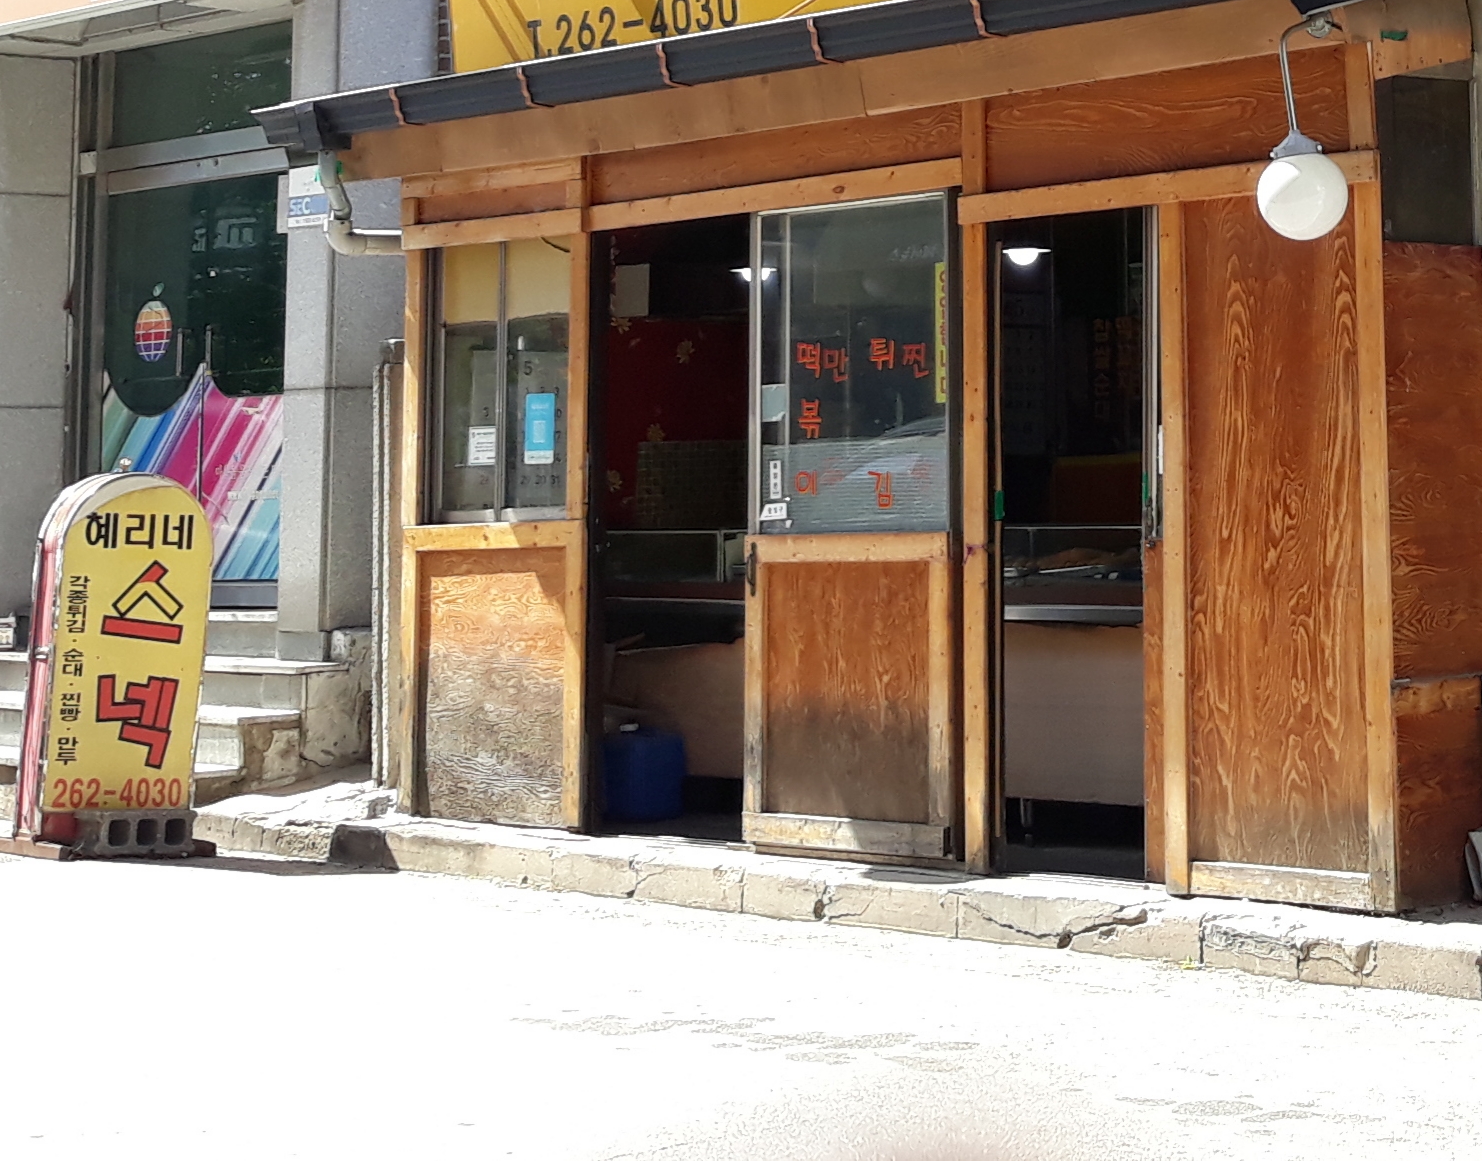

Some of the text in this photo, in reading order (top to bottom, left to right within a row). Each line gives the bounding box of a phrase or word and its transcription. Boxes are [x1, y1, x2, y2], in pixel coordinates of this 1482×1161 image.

[85, 513, 195, 550] 혜리네
[54, 575, 91, 766] 각종튀김 순대 찐빵 만두
[96, 560, 185, 770] 스넥
[52, 777, 182, 809] 262-4030
